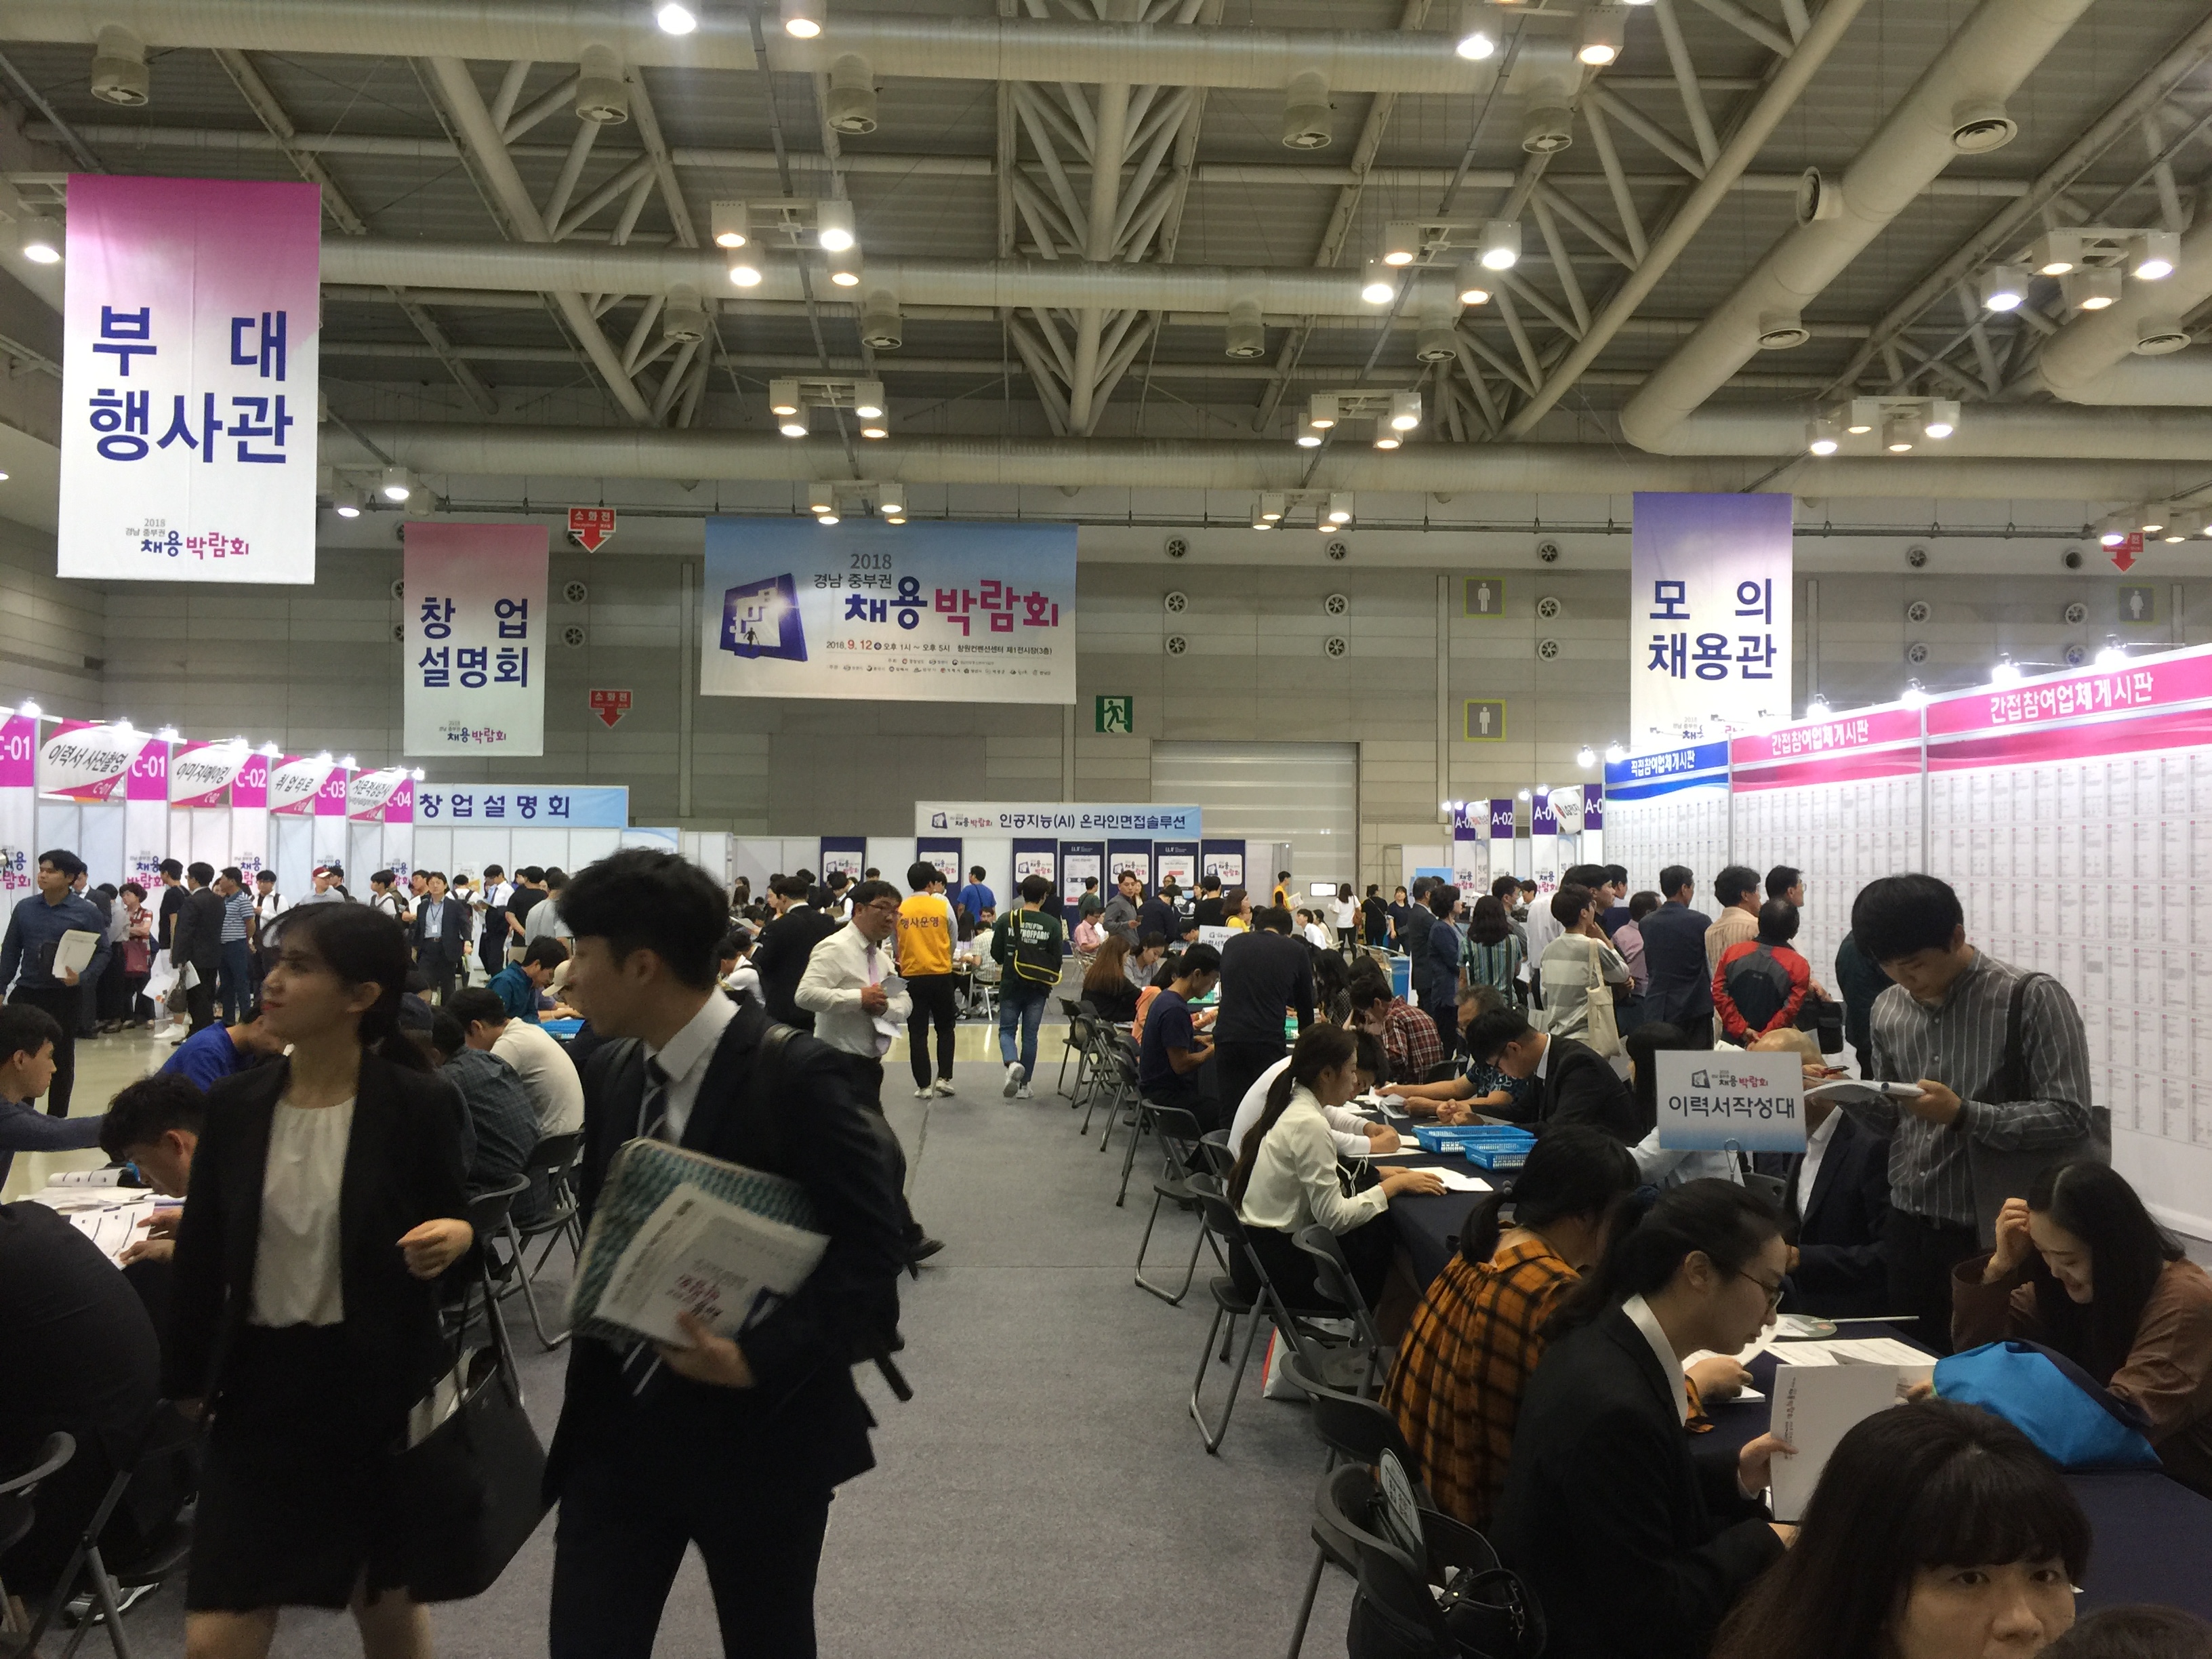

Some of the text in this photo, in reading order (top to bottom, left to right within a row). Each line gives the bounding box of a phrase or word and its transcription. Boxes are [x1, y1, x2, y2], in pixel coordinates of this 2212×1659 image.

[89, 389, 293, 464] 행사관
[144, 518, 166, 527] 2018
[125, 528, 165, 537] 경남 중부권
[141, 530, 249, 560] 채용 박람회
[850, 553, 893, 570] 2018
[813, 573, 893, 590] 경남 중부권
[844, 576, 1059, 636] 채용 박람회
[884, 642, 897, 651] 오후
[900, 643, 912, 651] 1시
[922, 644, 936, 652] 오후
[958, 644, 1004, 654] 창원컨벤션센터
[1647, 632, 1777, 680] 채용관
[418, 647, 529, 689] 설명회
[1990, 672, 2154, 724] 간접참여업체게시판
[447, 727, 506, 744] 채용 박람회
[1771, 720, 1868, 756] 간접참여업체게시판
[49, 745, 88, 767] 이력서
[1631, 750, 1696, 777] 직접참여업체게시판
[131, 756, 166, 777] C-01
[235, 769, 266, 788] C-02
[319, 781, 346, 798] C-03
[419, 794, 571, 819] 창업설명회
[1000, 813, 1185, 830] 인공지능(AI) 온라인면접솔루션
[1492, 812, 1513, 825] A-02
[136, 856, 160, 873] 채용
[241, 857, 262, 872] 채용
[1539, 871, 1555, 882] 채용
[899, 916, 939, 930] 행사운영
[1739, 1075, 1769, 1088] 박람회
[1668, 1095, 1795, 1120] 이력서작성대
